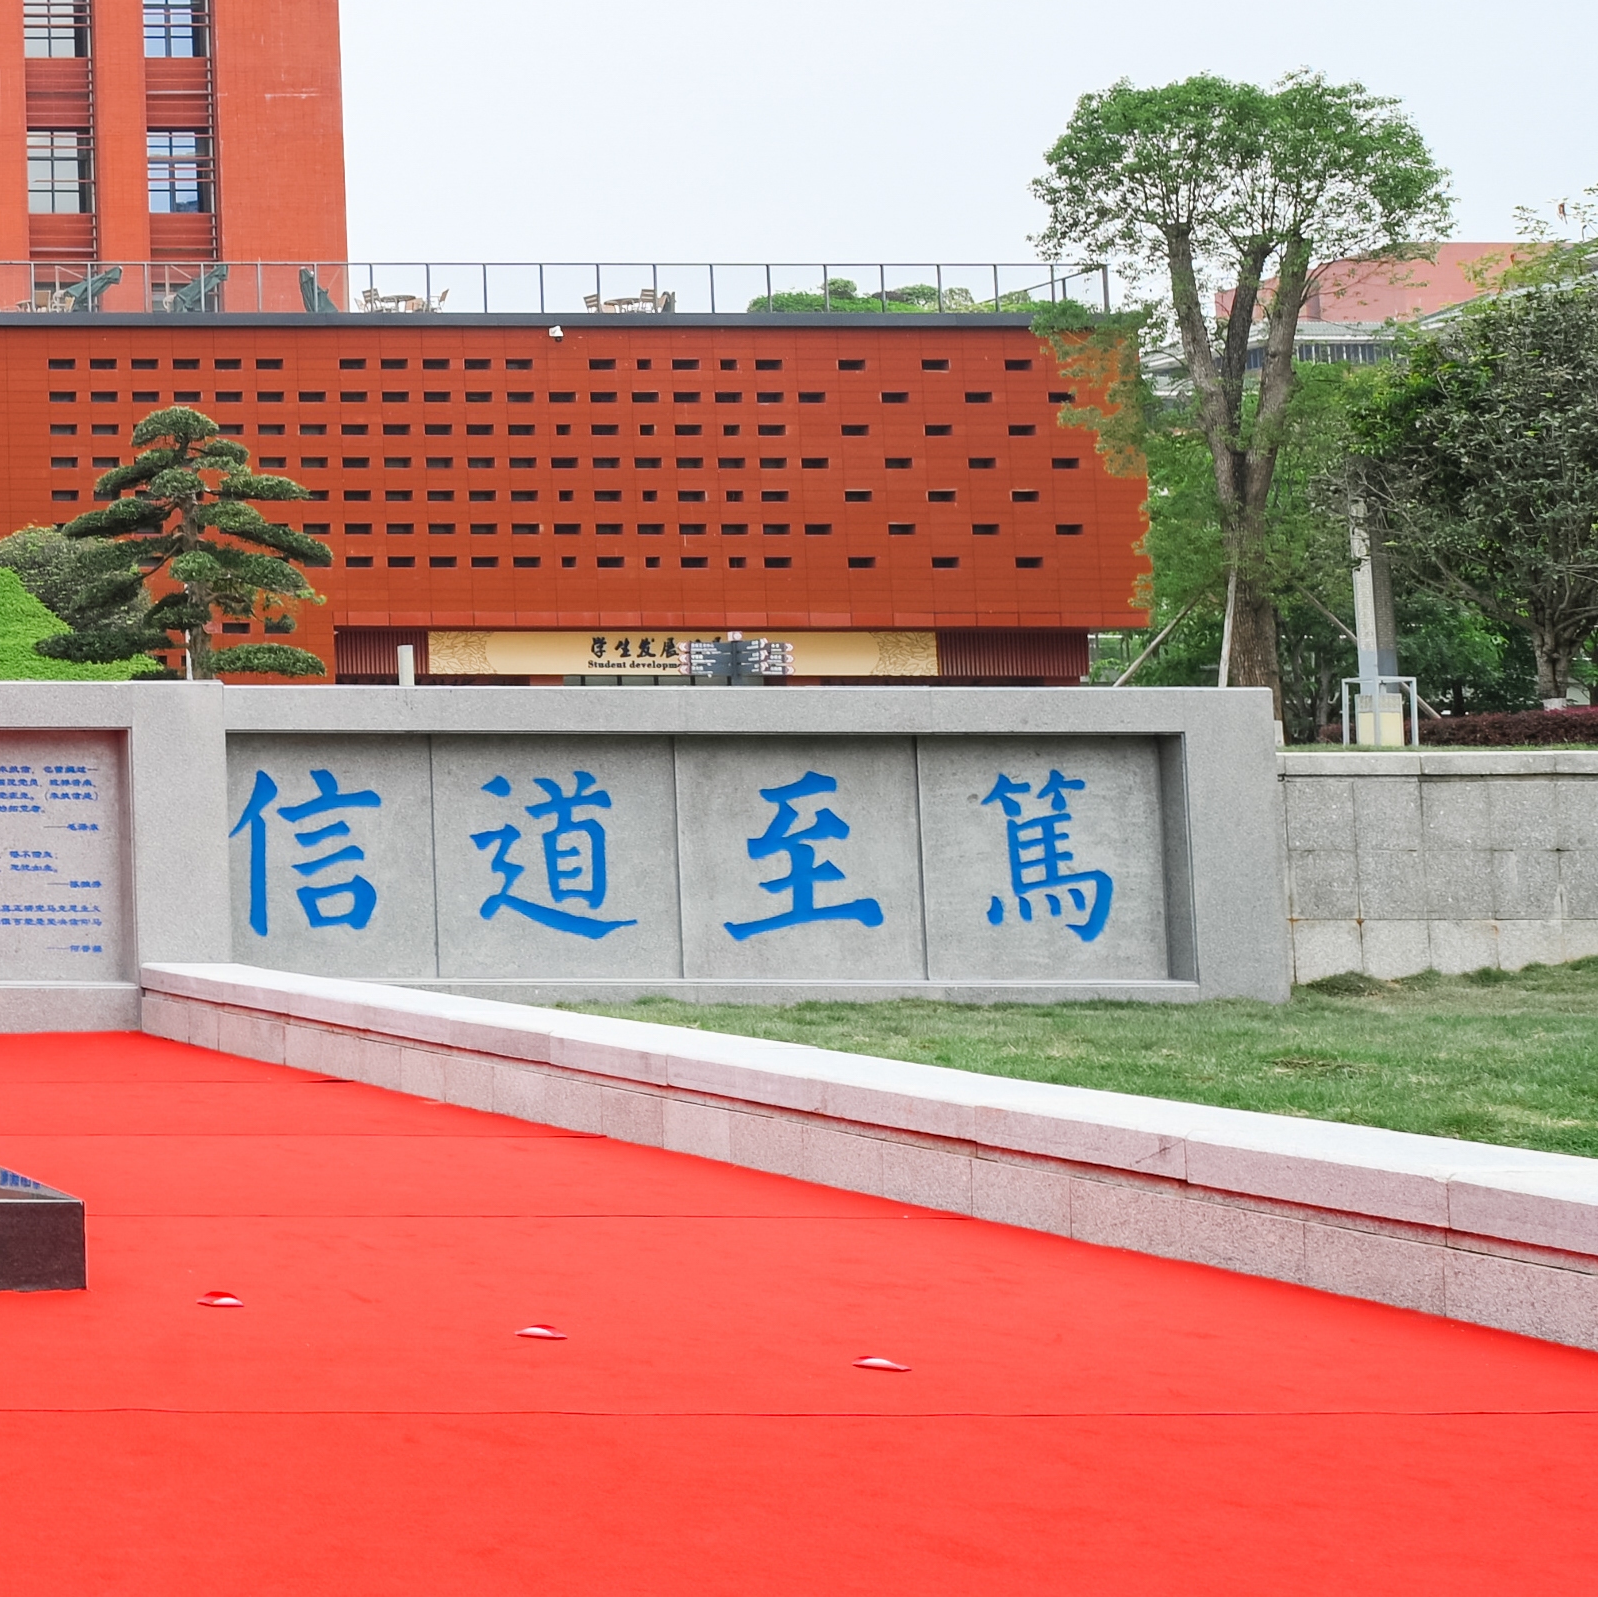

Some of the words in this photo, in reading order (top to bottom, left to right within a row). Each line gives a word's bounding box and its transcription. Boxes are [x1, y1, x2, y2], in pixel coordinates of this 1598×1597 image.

[588, 659, 627, 669] Student
[629, 659, 681, 671] developm
[228, 768, 1116, 944] 信道至篤
